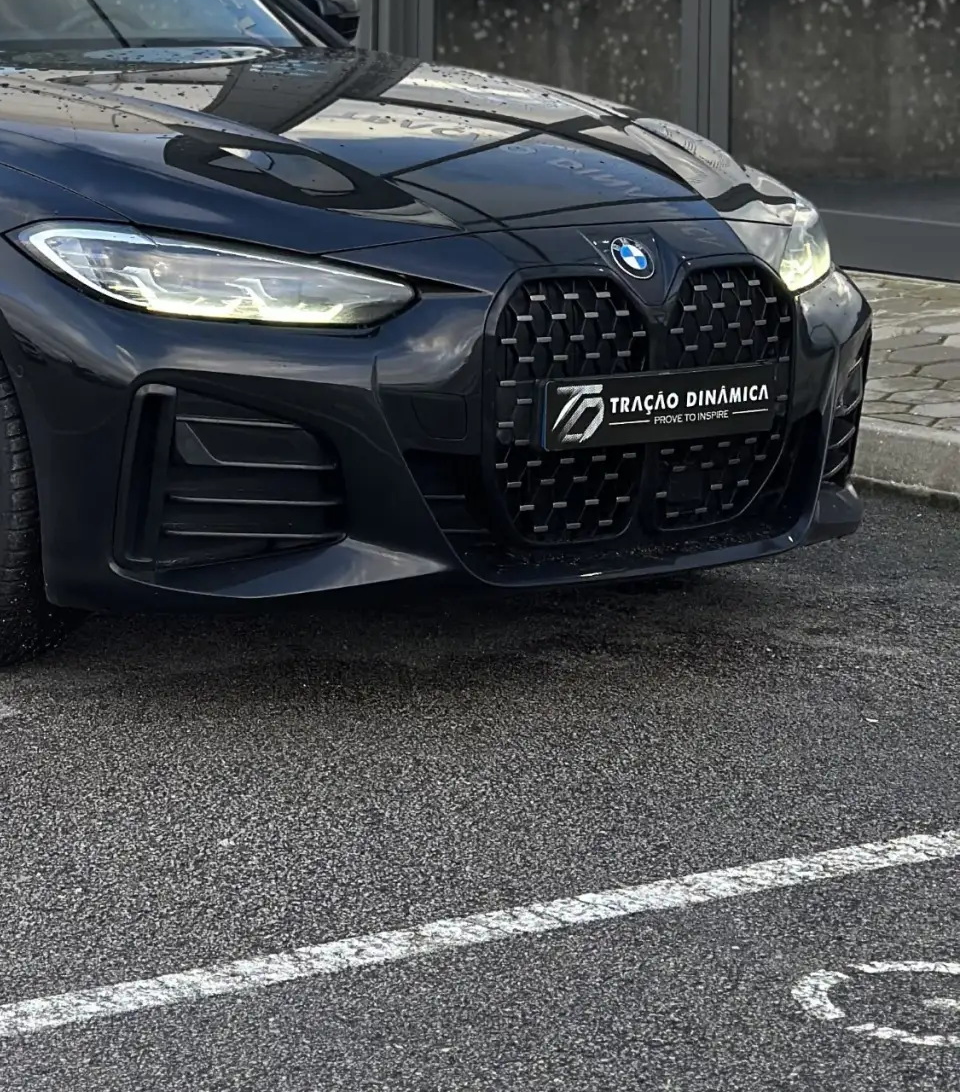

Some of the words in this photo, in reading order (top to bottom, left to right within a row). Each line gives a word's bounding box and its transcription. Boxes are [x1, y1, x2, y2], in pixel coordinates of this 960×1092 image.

[609, 391, 679, 415] TRAÇÃO
[686, 384, 769, 408] DINÂMICA
[654, 414, 683, 425] PROVE
[684, 412, 696, 422] TO
[697, 409, 730, 421] INSPIRE
